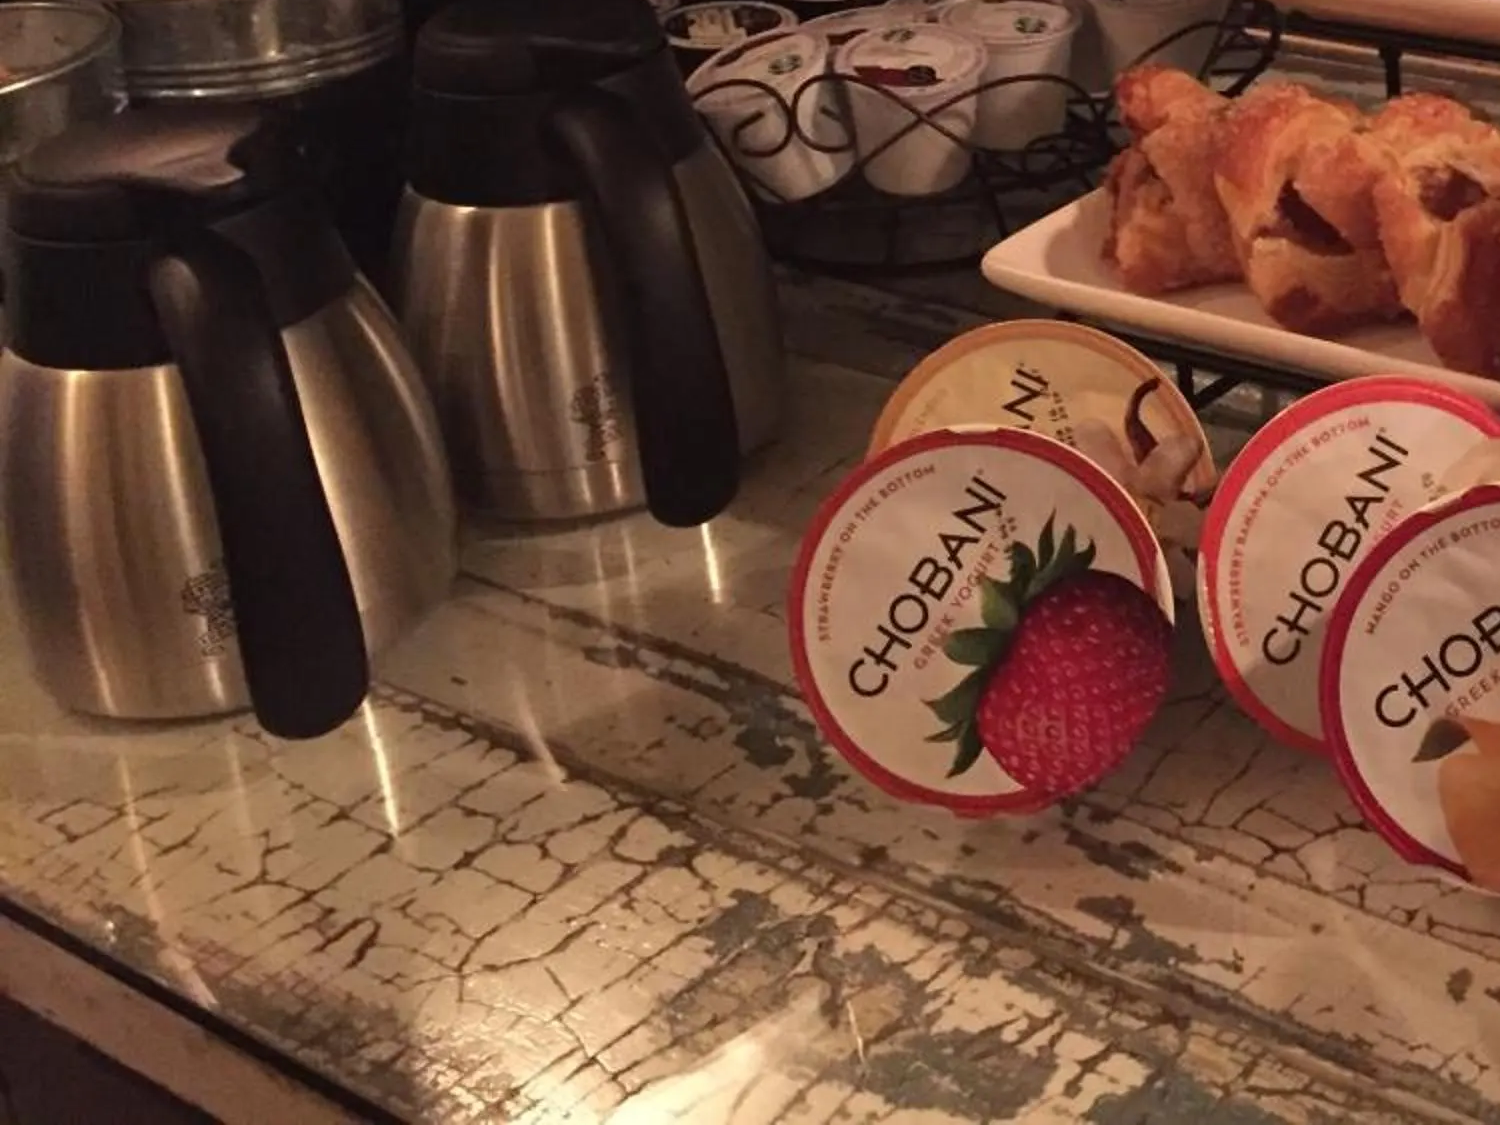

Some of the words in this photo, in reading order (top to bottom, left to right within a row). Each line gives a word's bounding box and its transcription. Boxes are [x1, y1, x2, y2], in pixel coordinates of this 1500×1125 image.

[1285, 444, 1309, 467] THE
[1312, 416, 1372, 447] BOTTOM
[817, 544, 844, 642] STRAWBERRY
[840, 522, 857, 543] ON
[855, 498, 880, 520] THE
[879, 464, 936, 500] BOTTOM
[849, 476, 1008, 698] CHOBANI
[913, 613, 955, 670] GREEK
[951, 542, 1000, 610] YOGURT
[1262, 434, 1409, 666] CHOBANI
[1366, 582, 1401, 635] MANGO
[1399, 558, 1420, 582] ON
[1420, 536, 1448, 560] THE
